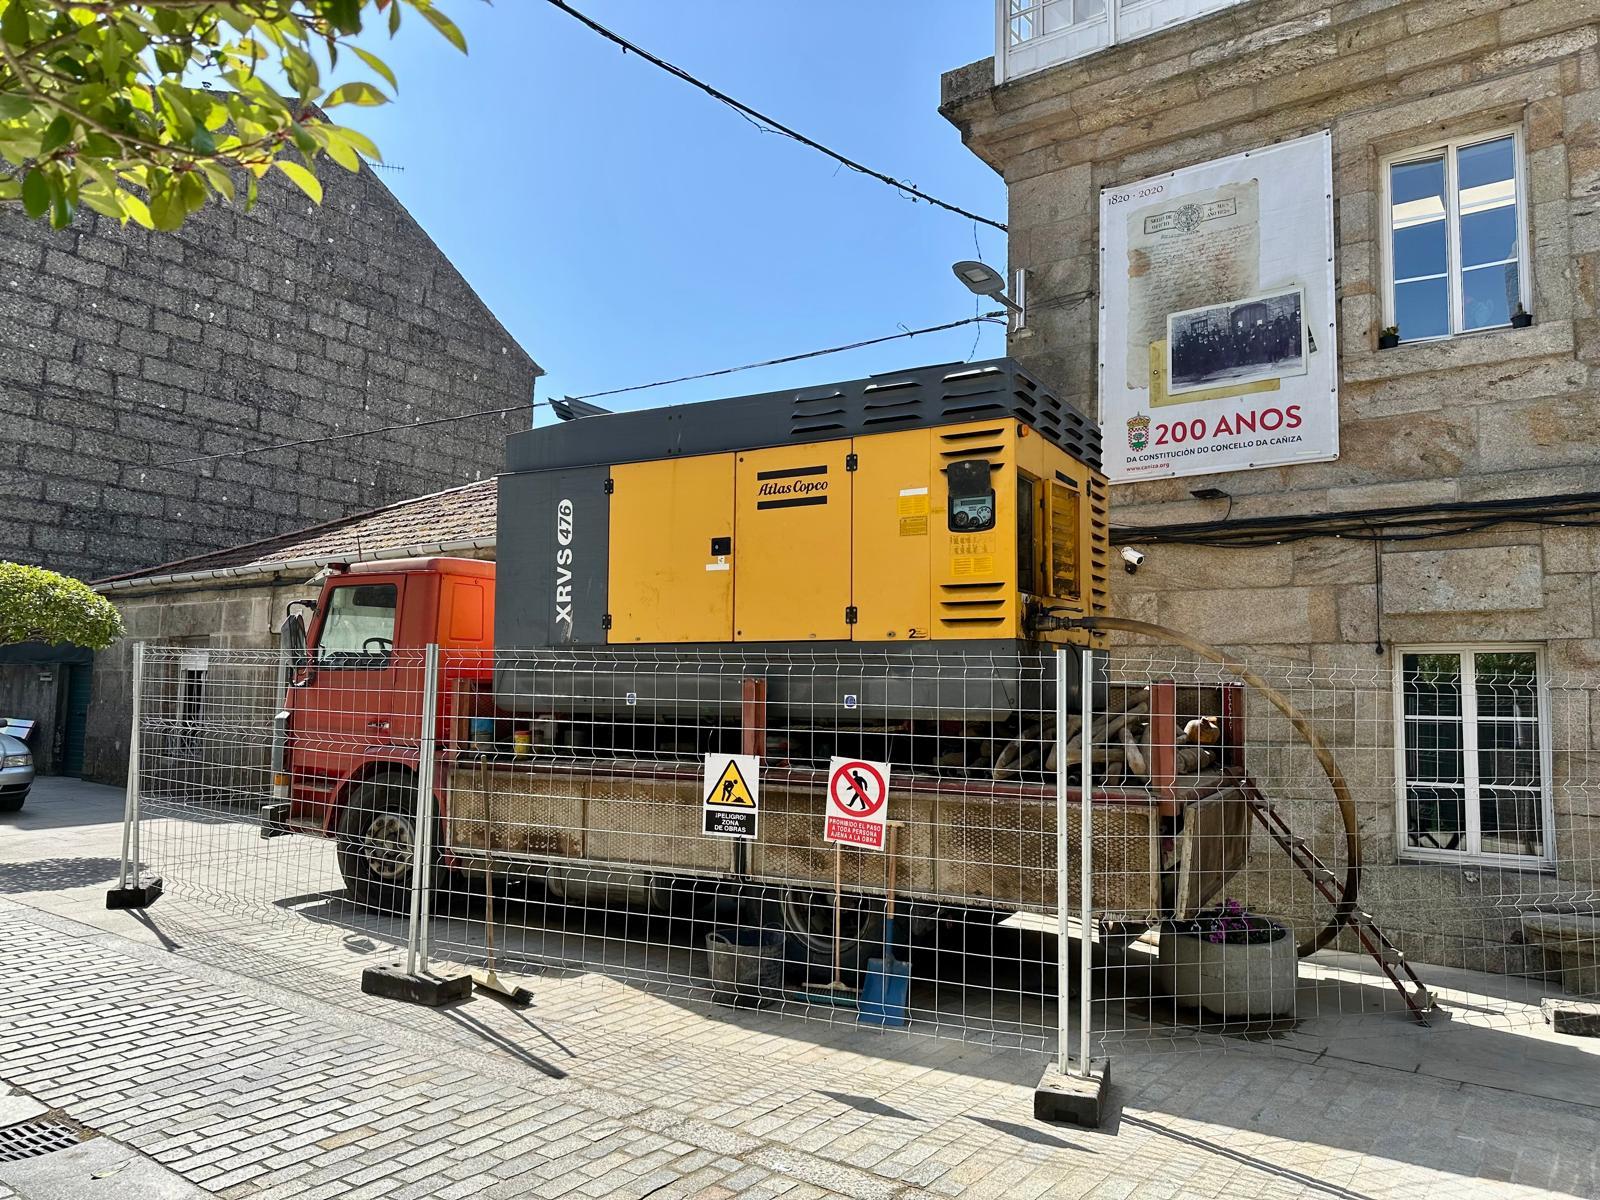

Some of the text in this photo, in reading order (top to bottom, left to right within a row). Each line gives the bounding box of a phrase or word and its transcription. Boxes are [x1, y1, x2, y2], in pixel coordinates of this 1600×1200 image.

[1108, 194, 1130, 206] 1820
[1138, 185, 1164, 198] 2020
[1155, 404, 1303, 446] 200 ANOS
[1126, 434, 1303, 464] DA CONSTITUCIÓN DO CONCELLO DA CAÑIZA
[1126, 461, 1170, 472] www.caniza.org
[757, 480, 828, 496] Atlas Copco
[555, 504, 574, 624] XRVS 476
[721, 819, 739, 827] ZONA
[723, 825, 747, 833] OBRAS
[829, 818, 858, 828] PROHIBIDO
[866, 824, 881, 832] PASO
[830, 831, 848, 839] AJENA
[861, 836, 877, 844] OBRA
[837, 825, 851, 833] TODA
[852, 828, 877, 837] PERSONA
